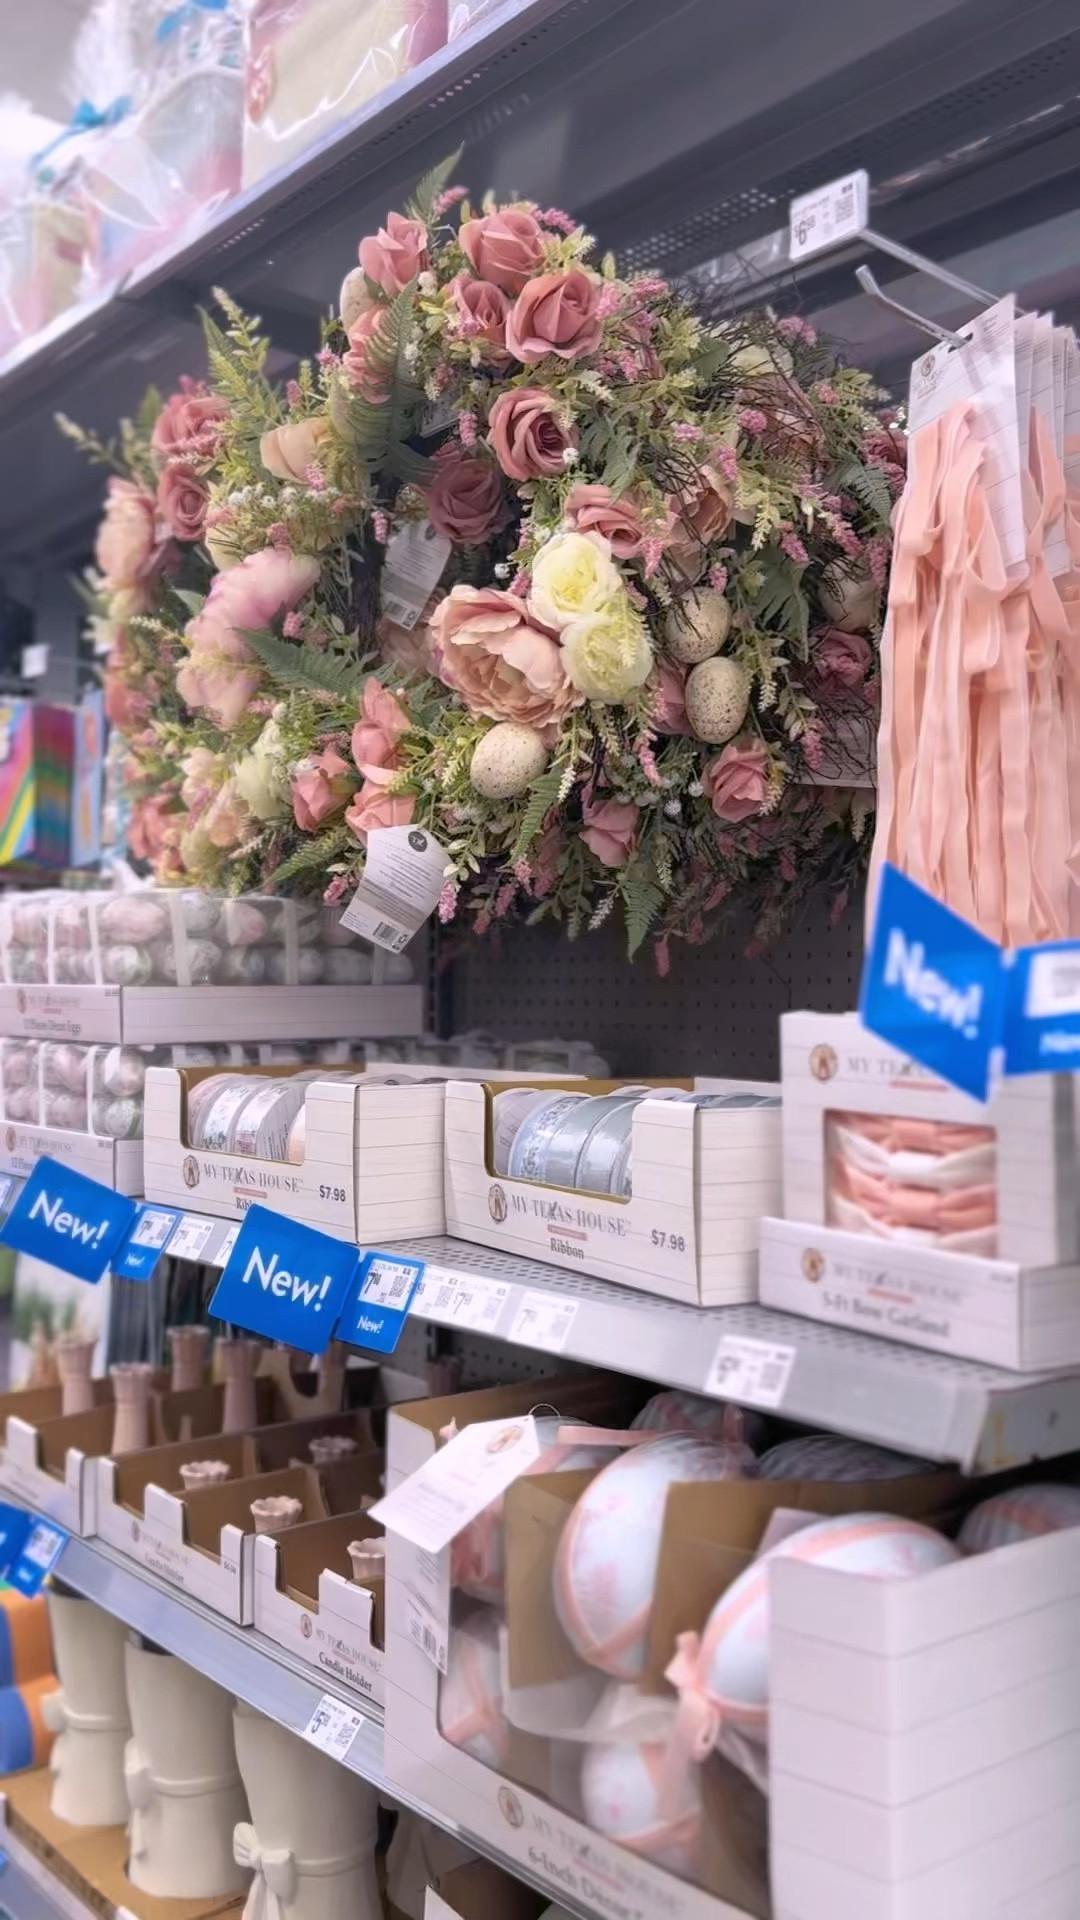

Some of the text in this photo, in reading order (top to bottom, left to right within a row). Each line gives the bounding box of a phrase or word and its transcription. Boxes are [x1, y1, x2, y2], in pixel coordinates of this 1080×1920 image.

[883, 927, 984, 1040] New!
[203, 1163, 217, 1177] MY
[220, 1165, 255, 1186] TEXAS
[259, 1172, 300, 1194] HOUSE
[318, 1184, 346, 1202] $7.98
[28, 1189, 110, 1250] New!
[511, 1194, 528, 1213] MY
[533, 1199, 575, 1225] TEXAS
[577, 1210, 627, 1237] HOUSE
[550, 1237, 585, 1261] Ribbon
[651, 1229, 686, 1252] $7.98
[242, 1246, 332, 1313] New!
[356, 1315, 384, 1335] New!
[318, 1651, 372, 1692] Candle Holder
